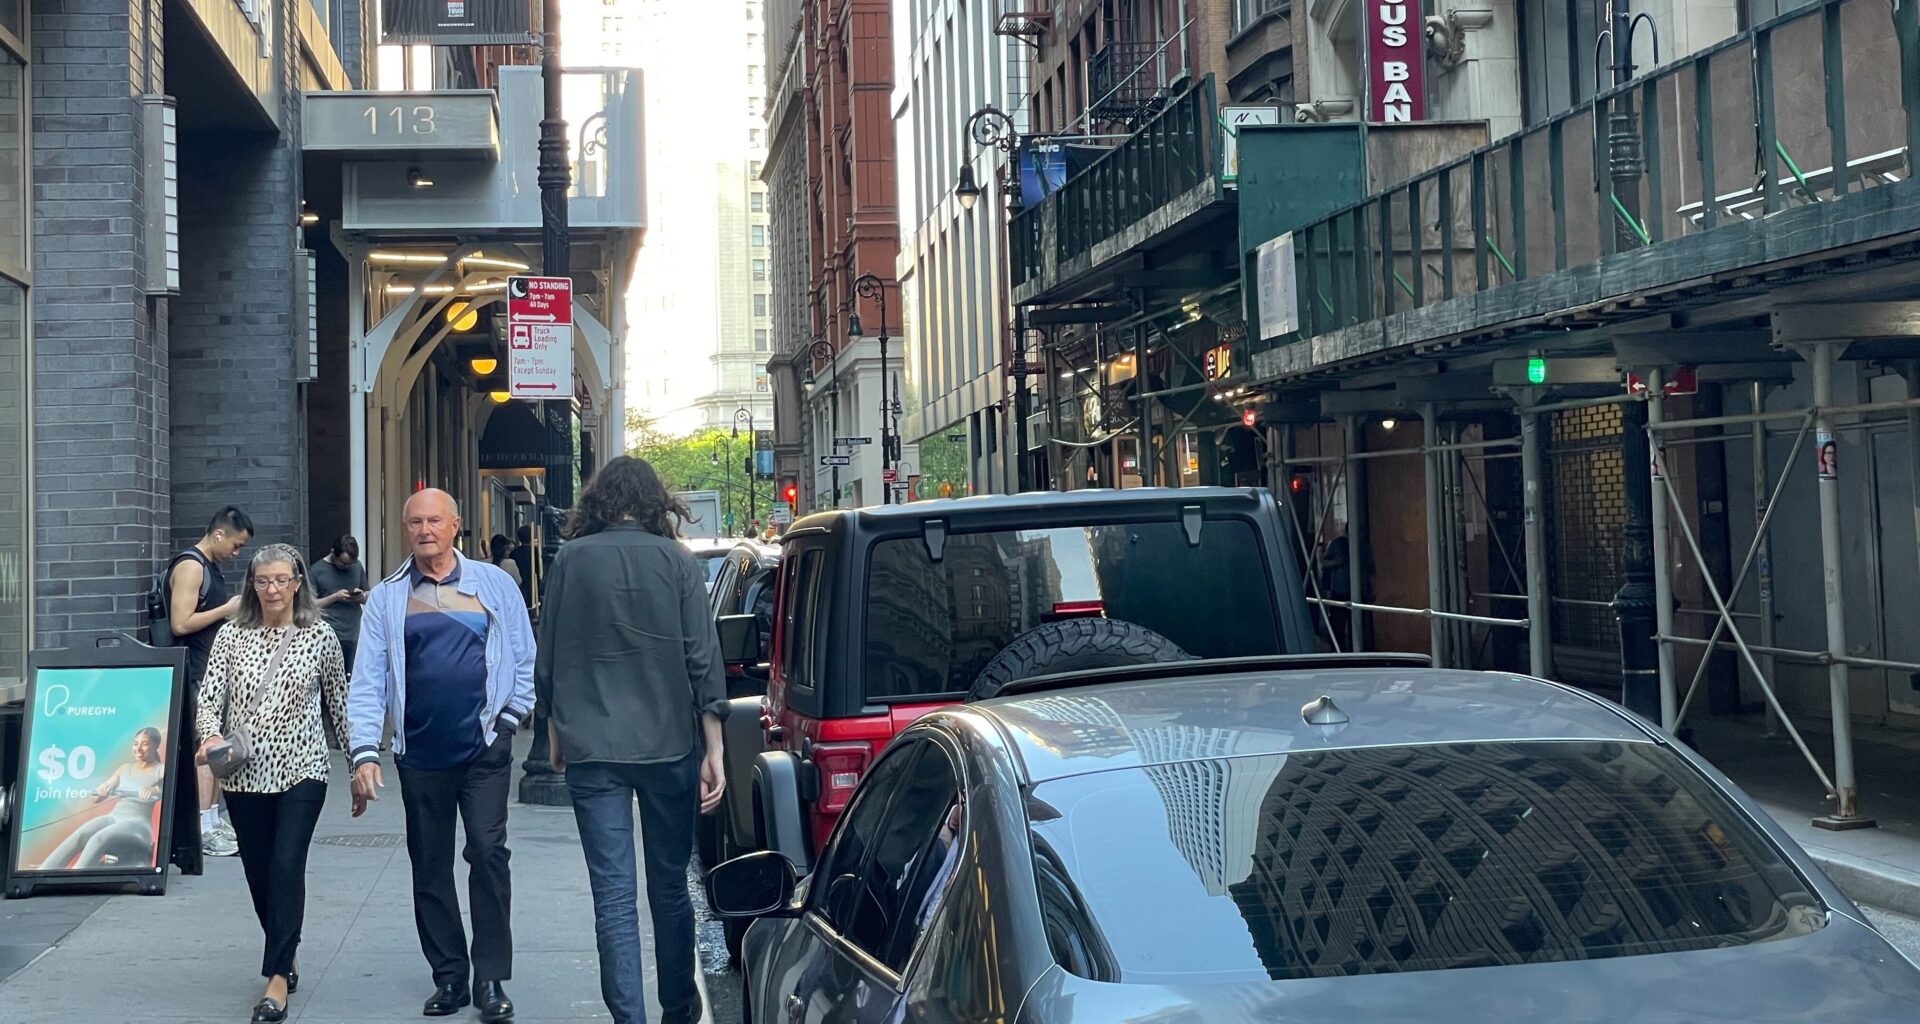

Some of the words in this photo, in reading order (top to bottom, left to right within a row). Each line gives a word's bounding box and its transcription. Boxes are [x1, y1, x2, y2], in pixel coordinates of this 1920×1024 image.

[1380, 0, 1407, 47] US
[363, 106, 435, 134] 113
[1038, 144, 1060, 152] NYC
[529, 281, 538, 289] NO
[539, 281, 569, 290] STANDING
[537, 301, 549, 309] Days
[534, 336, 557, 344] Loading
[514, 357, 526, 365] 7am
[514, 367, 534, 375] Except
[67, 706, 117, 716] PUREGYM
[37, 743, 96, 785] $0
[34, 786, 61, 802] join
[65, 786, 88, 799] fee
